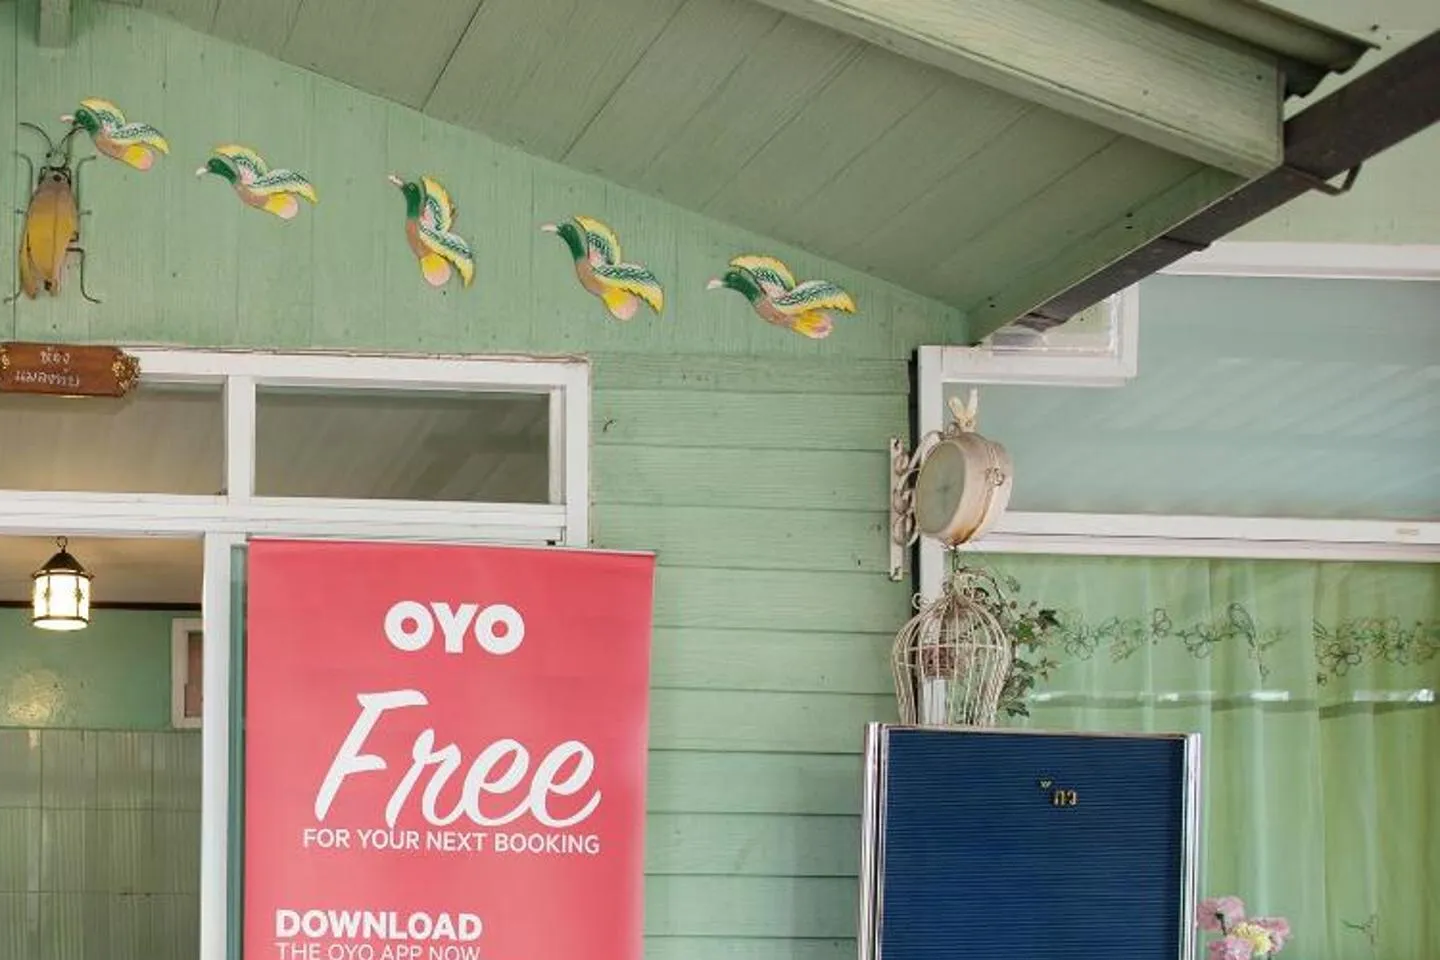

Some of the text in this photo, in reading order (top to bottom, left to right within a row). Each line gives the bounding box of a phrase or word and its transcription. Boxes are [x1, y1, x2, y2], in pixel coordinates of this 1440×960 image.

[383, 600, 525, 654] OYO
[313, 689, 602, 829] Free
[303, 828, 601, 854] FOR YOUR NEXT BOOKING
[275, 909, 483, 942] DOWNLOAD
